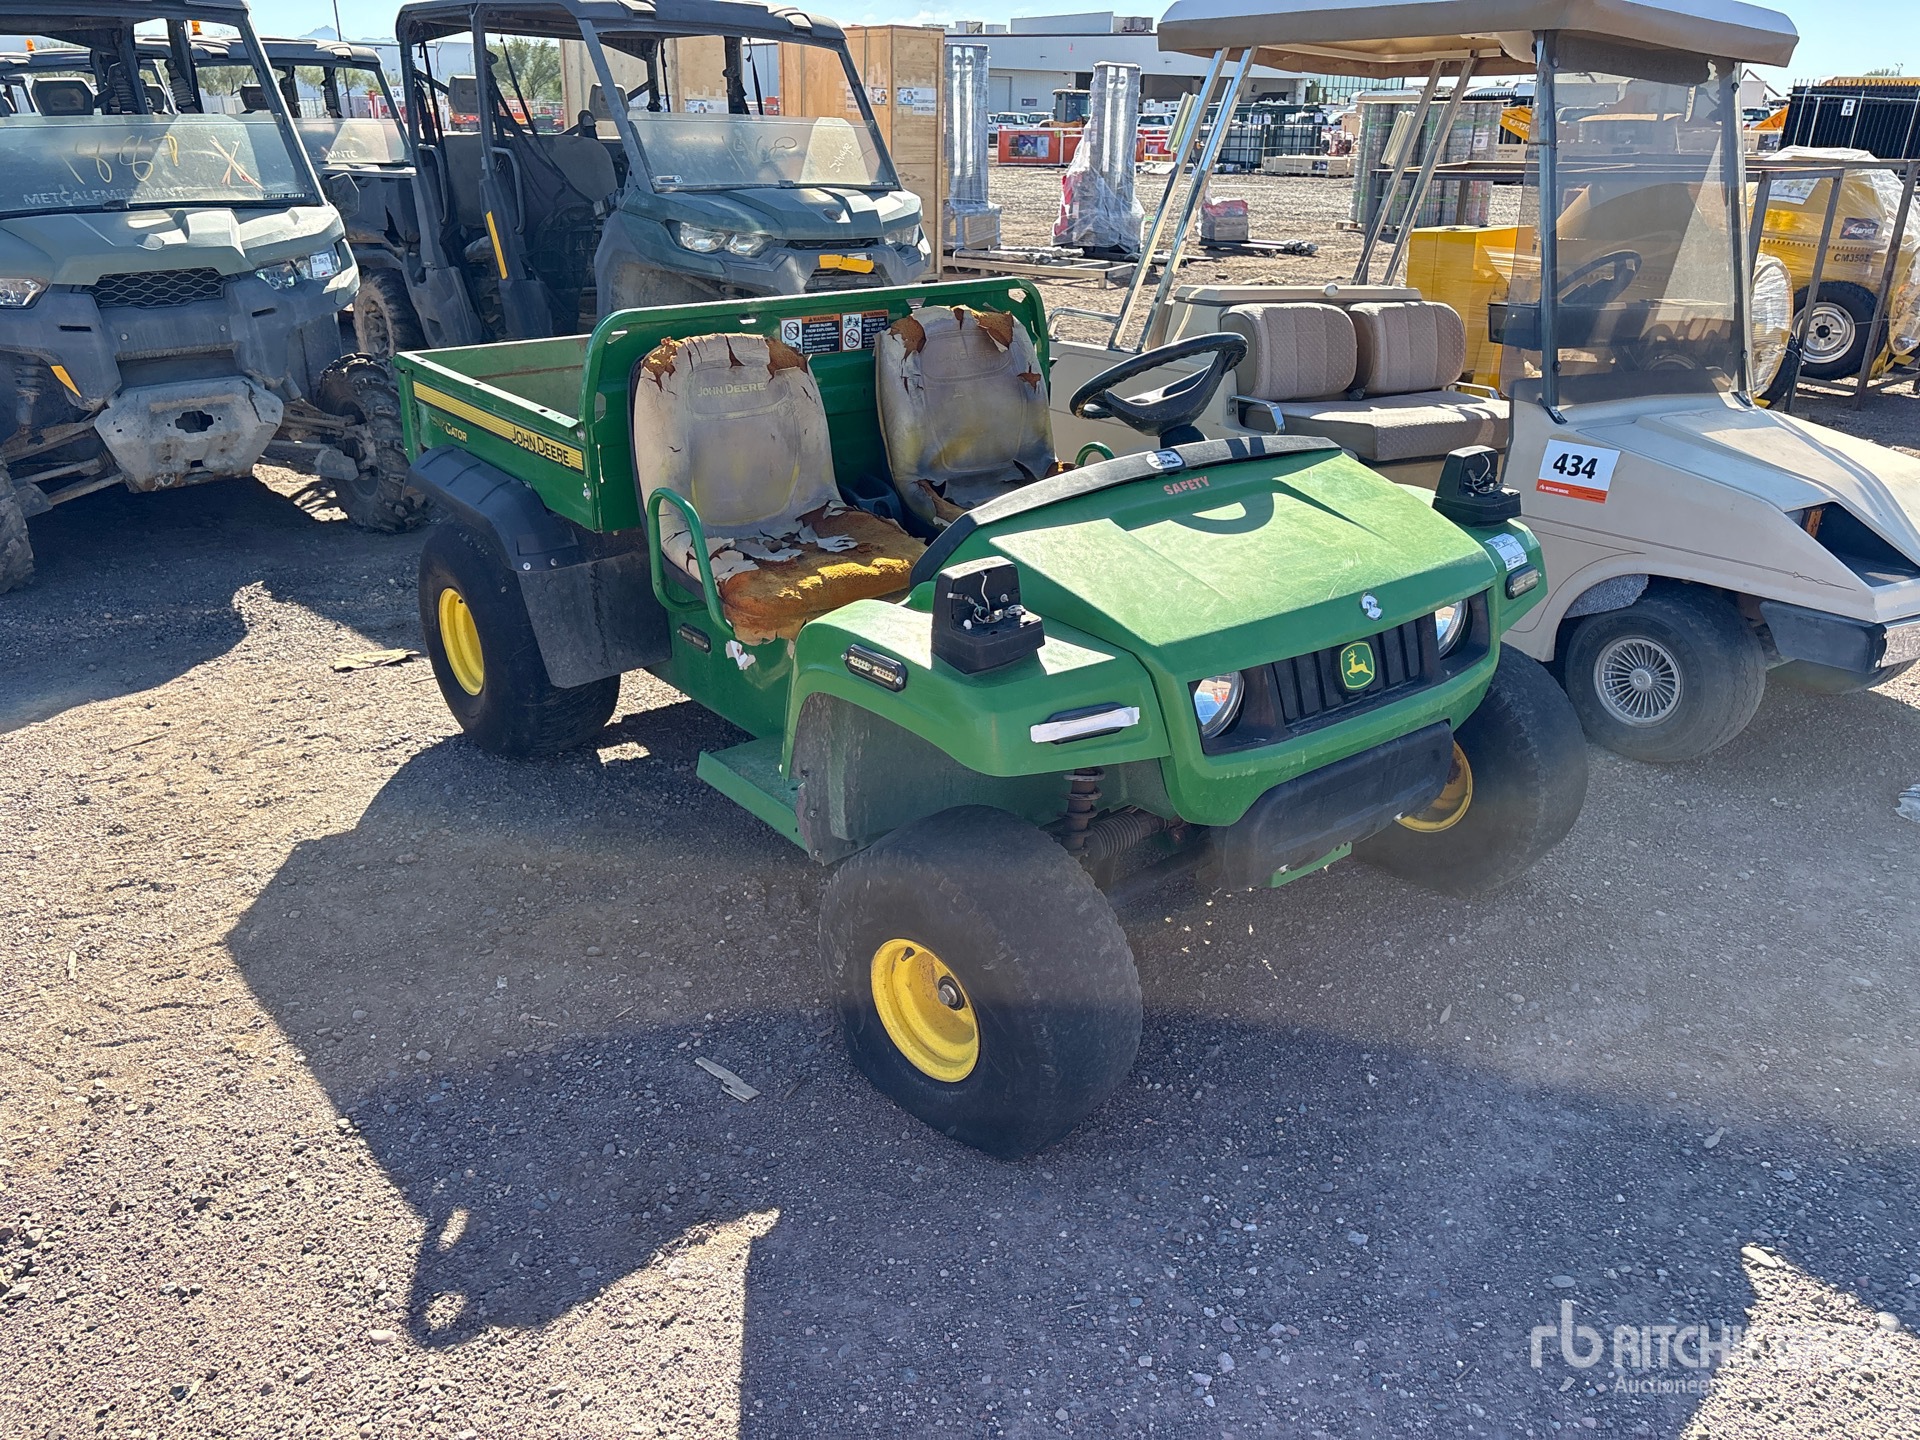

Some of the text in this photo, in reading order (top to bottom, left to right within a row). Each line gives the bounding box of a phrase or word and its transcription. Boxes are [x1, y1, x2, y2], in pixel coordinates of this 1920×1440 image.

[697, 382, 767, 397] JOHN DEERE
[511, 426, 571, 467] JOHN DEERE
[1552, 452, 1598, 480] 434
[1163, 475, 1210, 495] SAFETY
